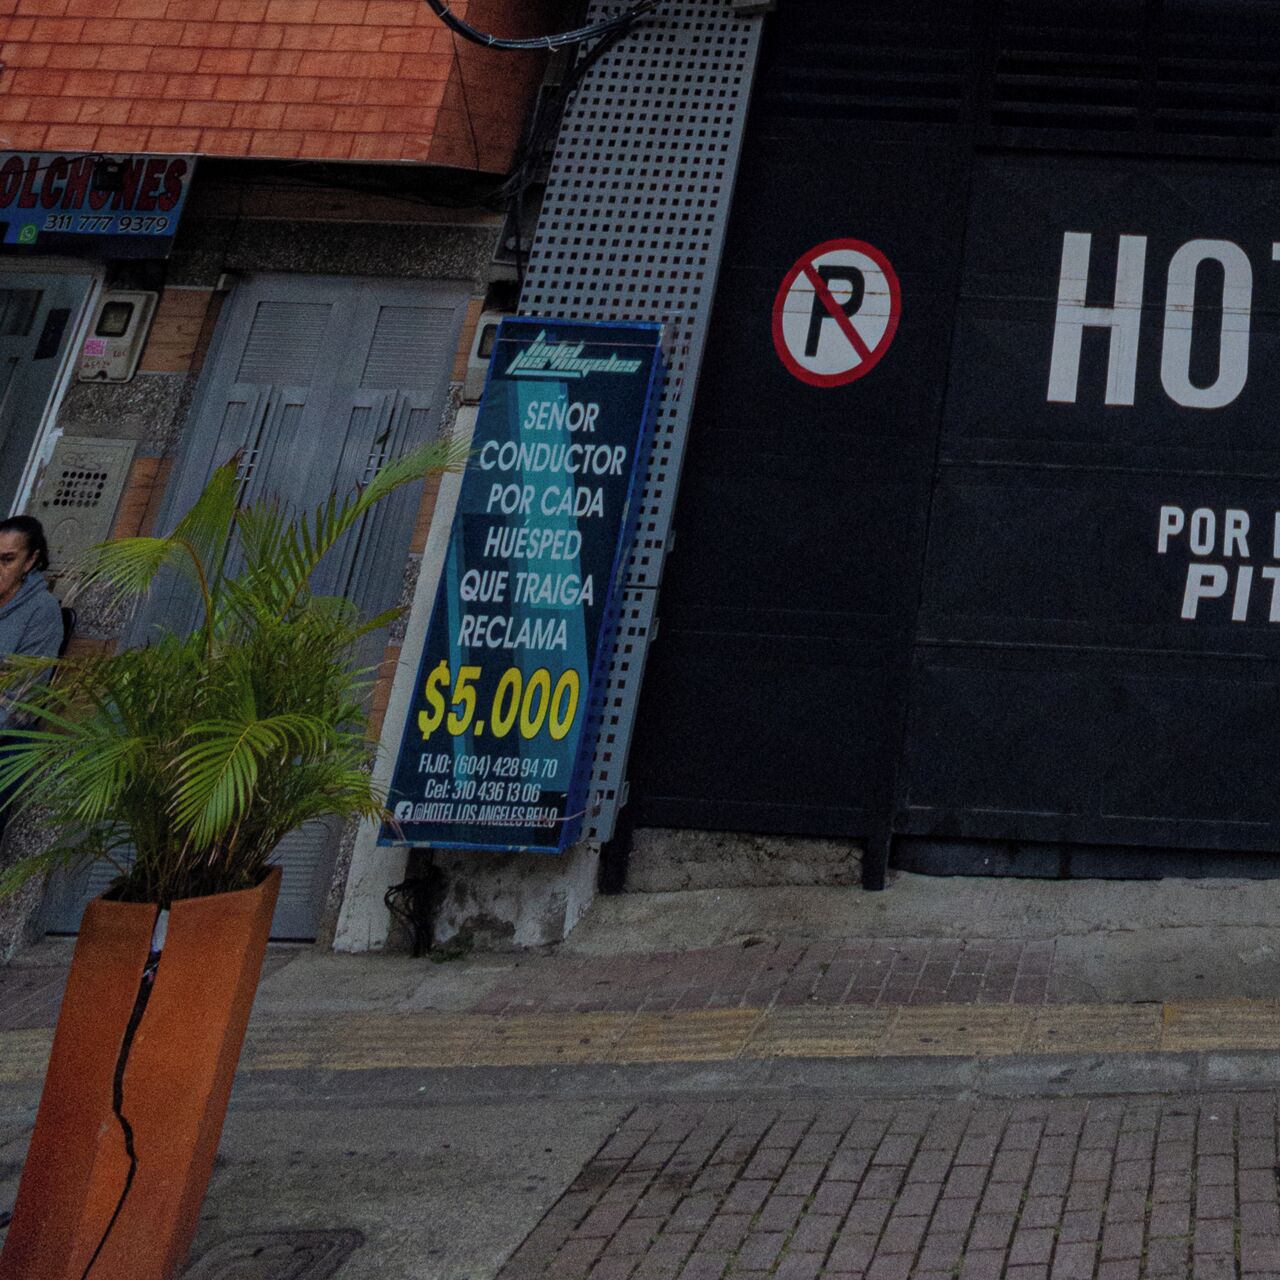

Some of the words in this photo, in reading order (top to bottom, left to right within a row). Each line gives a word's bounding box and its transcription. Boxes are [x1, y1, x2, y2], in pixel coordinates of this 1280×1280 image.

[43, 214, 73, 232] 311
[78, 215, 114, 233] 777
[118, 216, 169, 234] 9379
[524, 395, 600, 433] SEÑOR
[479, 439, 628, 476] CONDUCTOR
[486, 483, 535, 515] POR
[541, 486, 604, 519] CADA
[484, 520, 583, 561] HUÉSPED
[1157, 505, 1252, 559] POR
[460, 568, 509, 603] QUE
[515, 571, 595, 608] TRAIGA
[457, 613, 569, 651] RECLAMA
[417, 659, 581, 742] $5.000
[418, 753, 452, 774] FIJO:
[453, 754, 491, 779] (604)
[492, 756, 520, 777] 428
[520, 757, 540, 778] 94
[542, 758, 559, 779] 70
[425, 778, 451, 799] Cel:
[451, 781, 477, 800] 310
[477, 781, 506, 802] 436
[506, 782, 520, 802] 13
[521, 783, 542, 804] 06
[456, 804, 478, 825] LOS
[479, 805, 525, 827] ANGELES
[525, 807, 559, 829] BELLO
